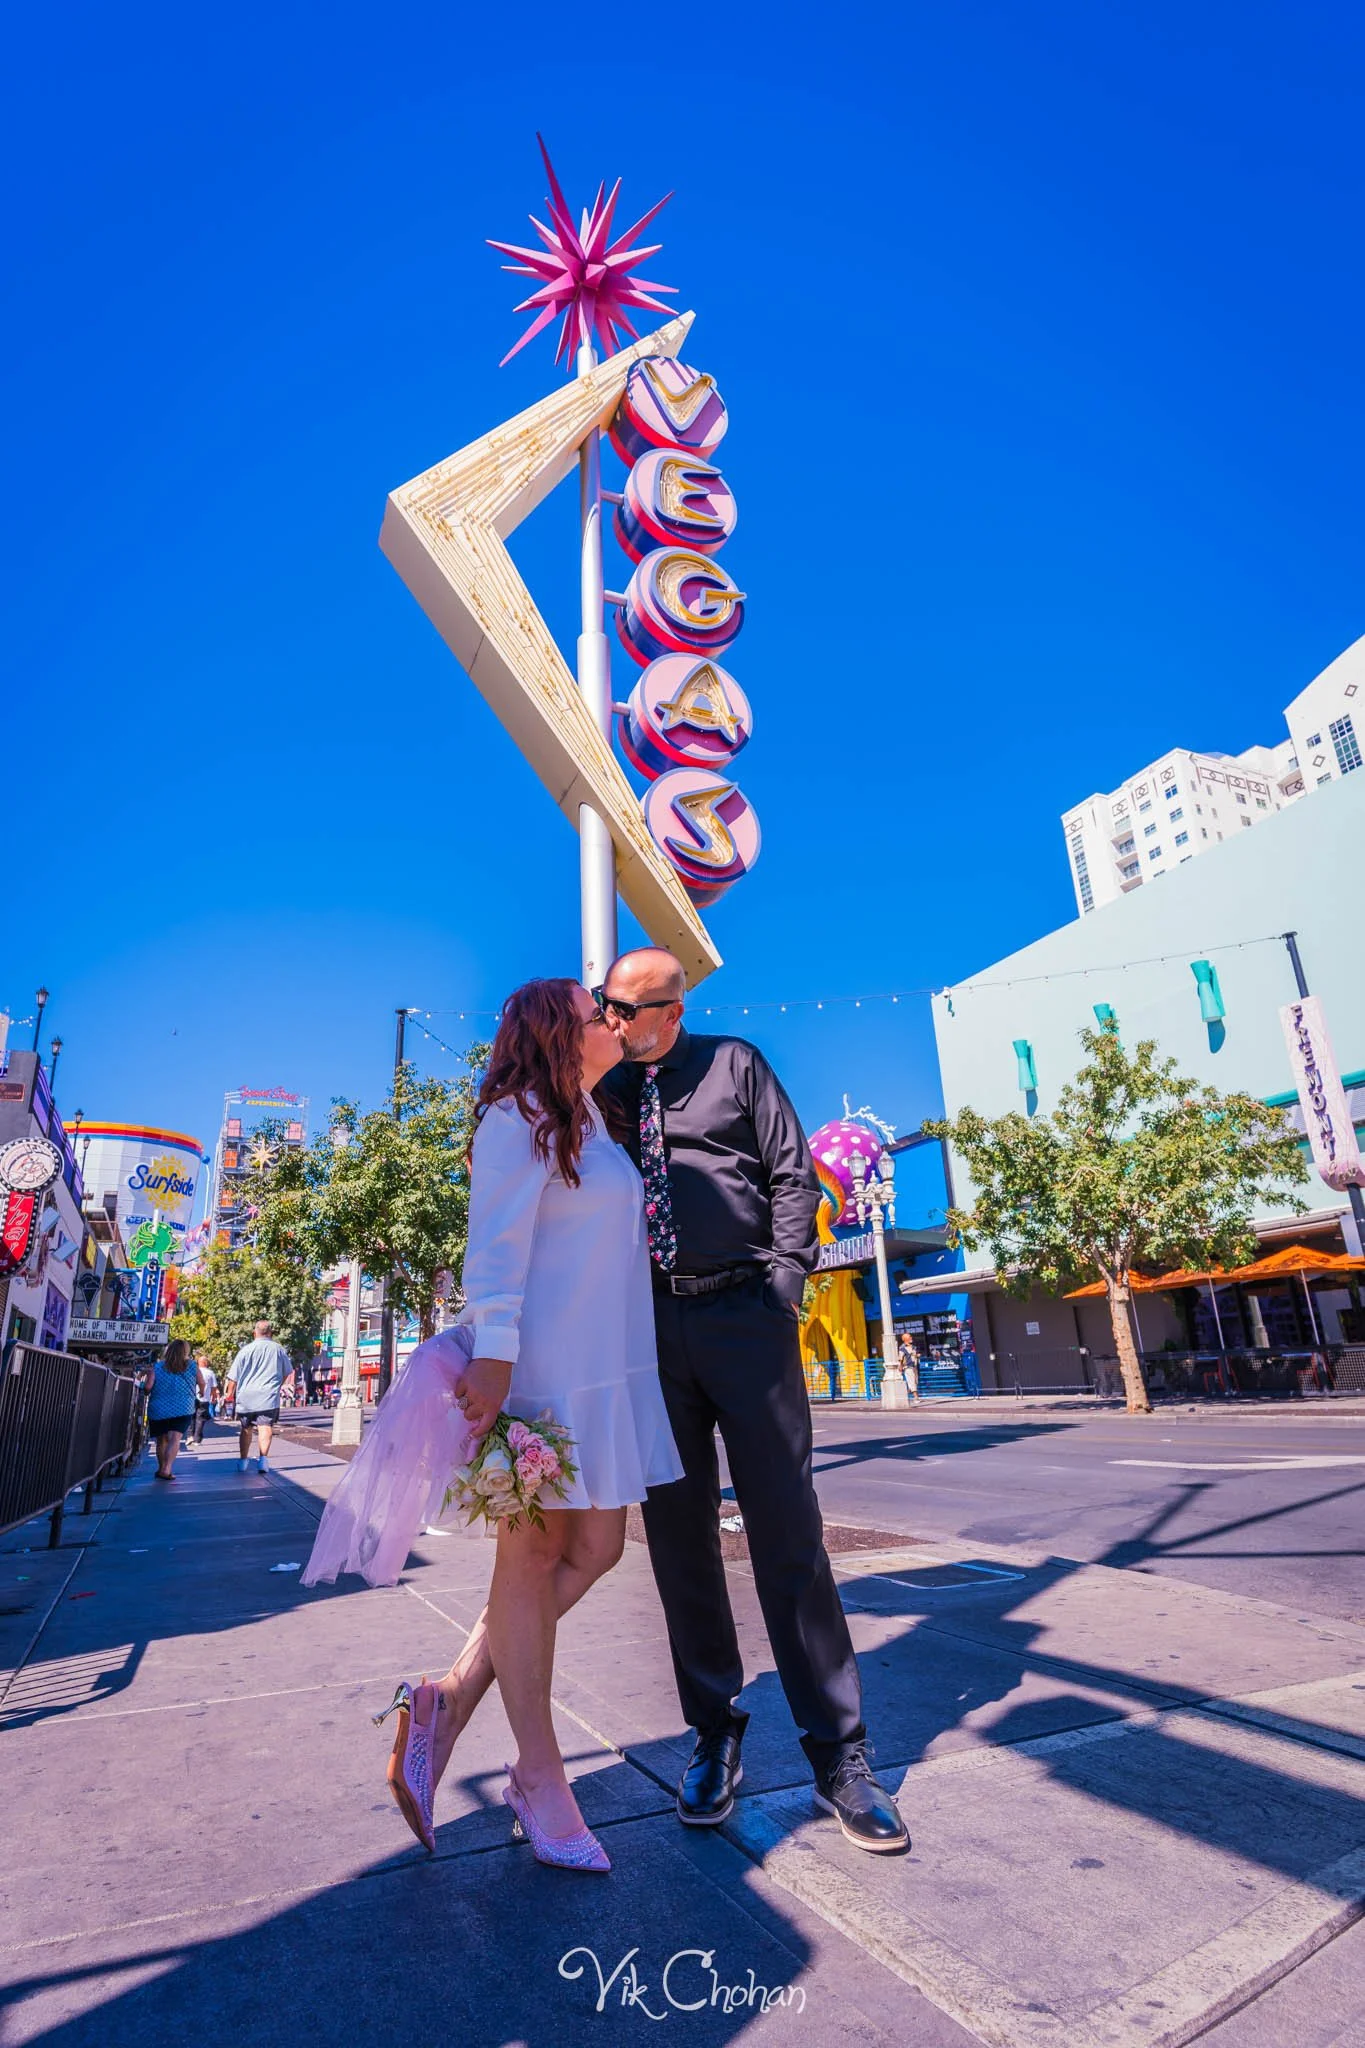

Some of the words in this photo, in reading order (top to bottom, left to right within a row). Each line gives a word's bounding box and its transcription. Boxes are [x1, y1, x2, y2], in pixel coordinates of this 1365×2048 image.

[638, 356, 748, 870] VEGAS
[1290, 1004, 1336, 1161] FREMONT
[128, 1164, 194, 1198] Surfside
[72, 1329, 108, 1340] HABANERO
[114, 1331, 136, 1341] PICKLE
[143, 1333, 159, 1342] BACK
[92, 1321, 101, 1330] OF
[105, 1321, 116, 1331] THE
[120, 1322, 140, 1332] WORLD
[143, 1323, 166, 1334] FAMOUS
